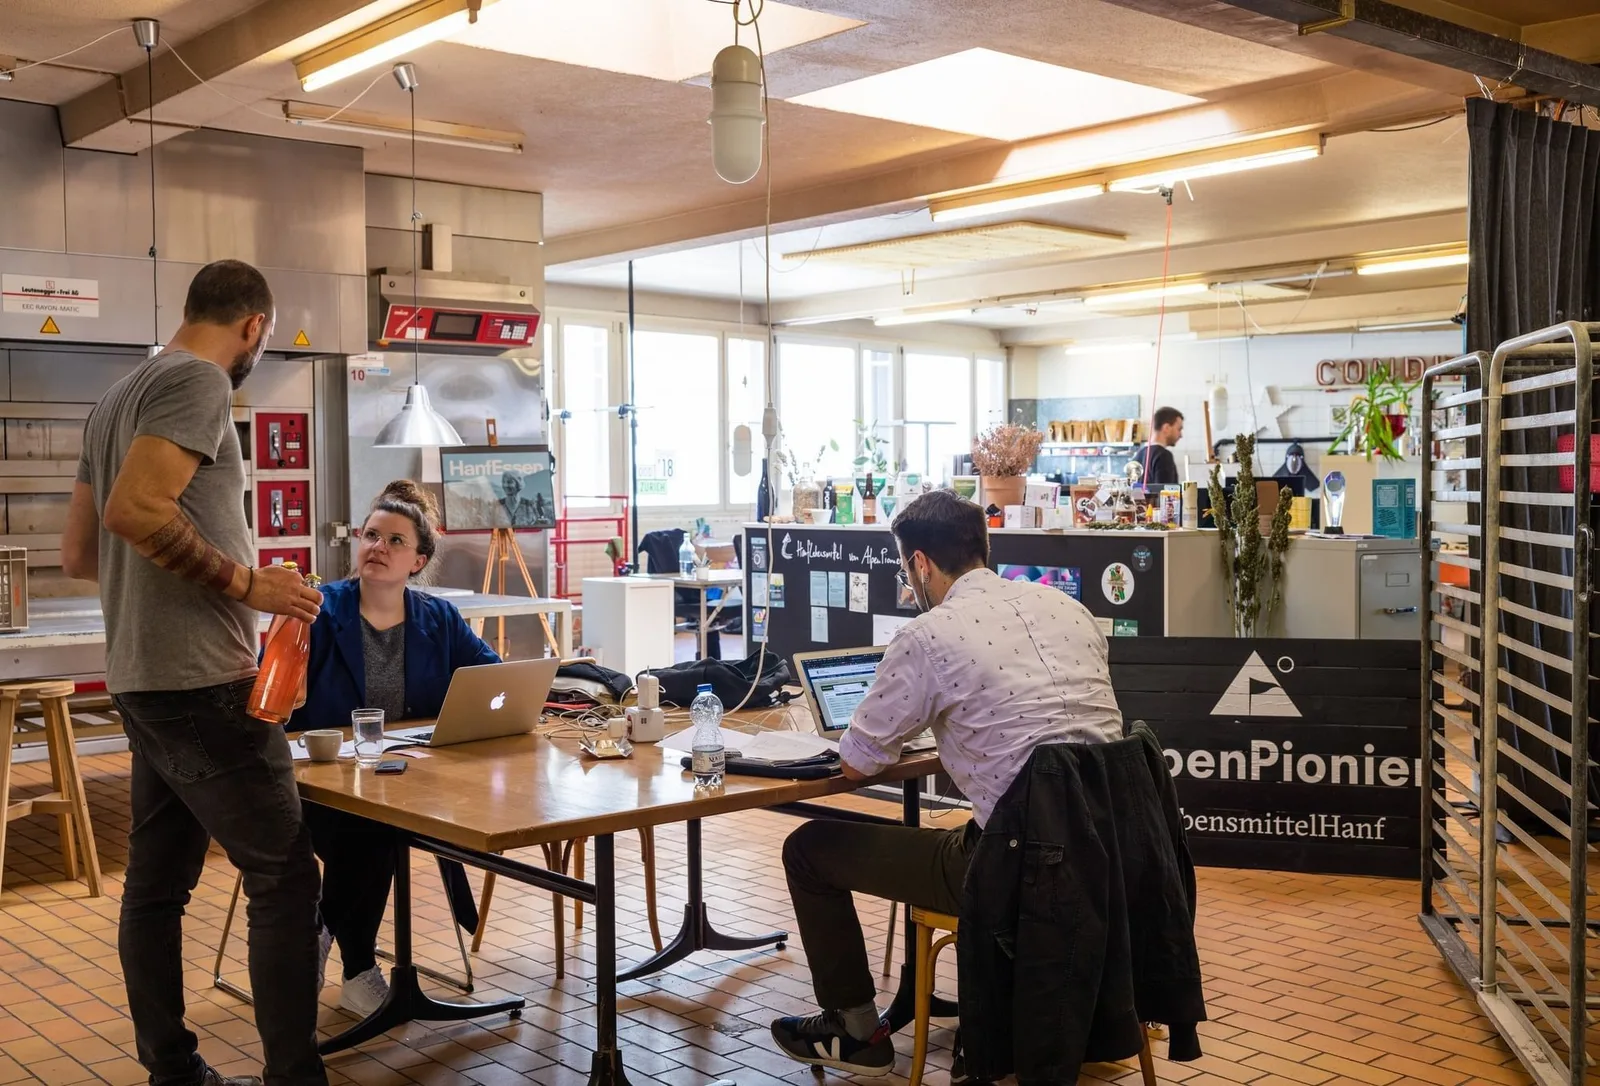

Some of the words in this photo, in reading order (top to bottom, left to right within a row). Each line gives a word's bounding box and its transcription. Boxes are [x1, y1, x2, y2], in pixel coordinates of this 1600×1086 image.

[21, 286, 56, 296] Leutenegger
[351, 369, 365, 381] 10
[449, 459, 545, 477] HanfEssen
